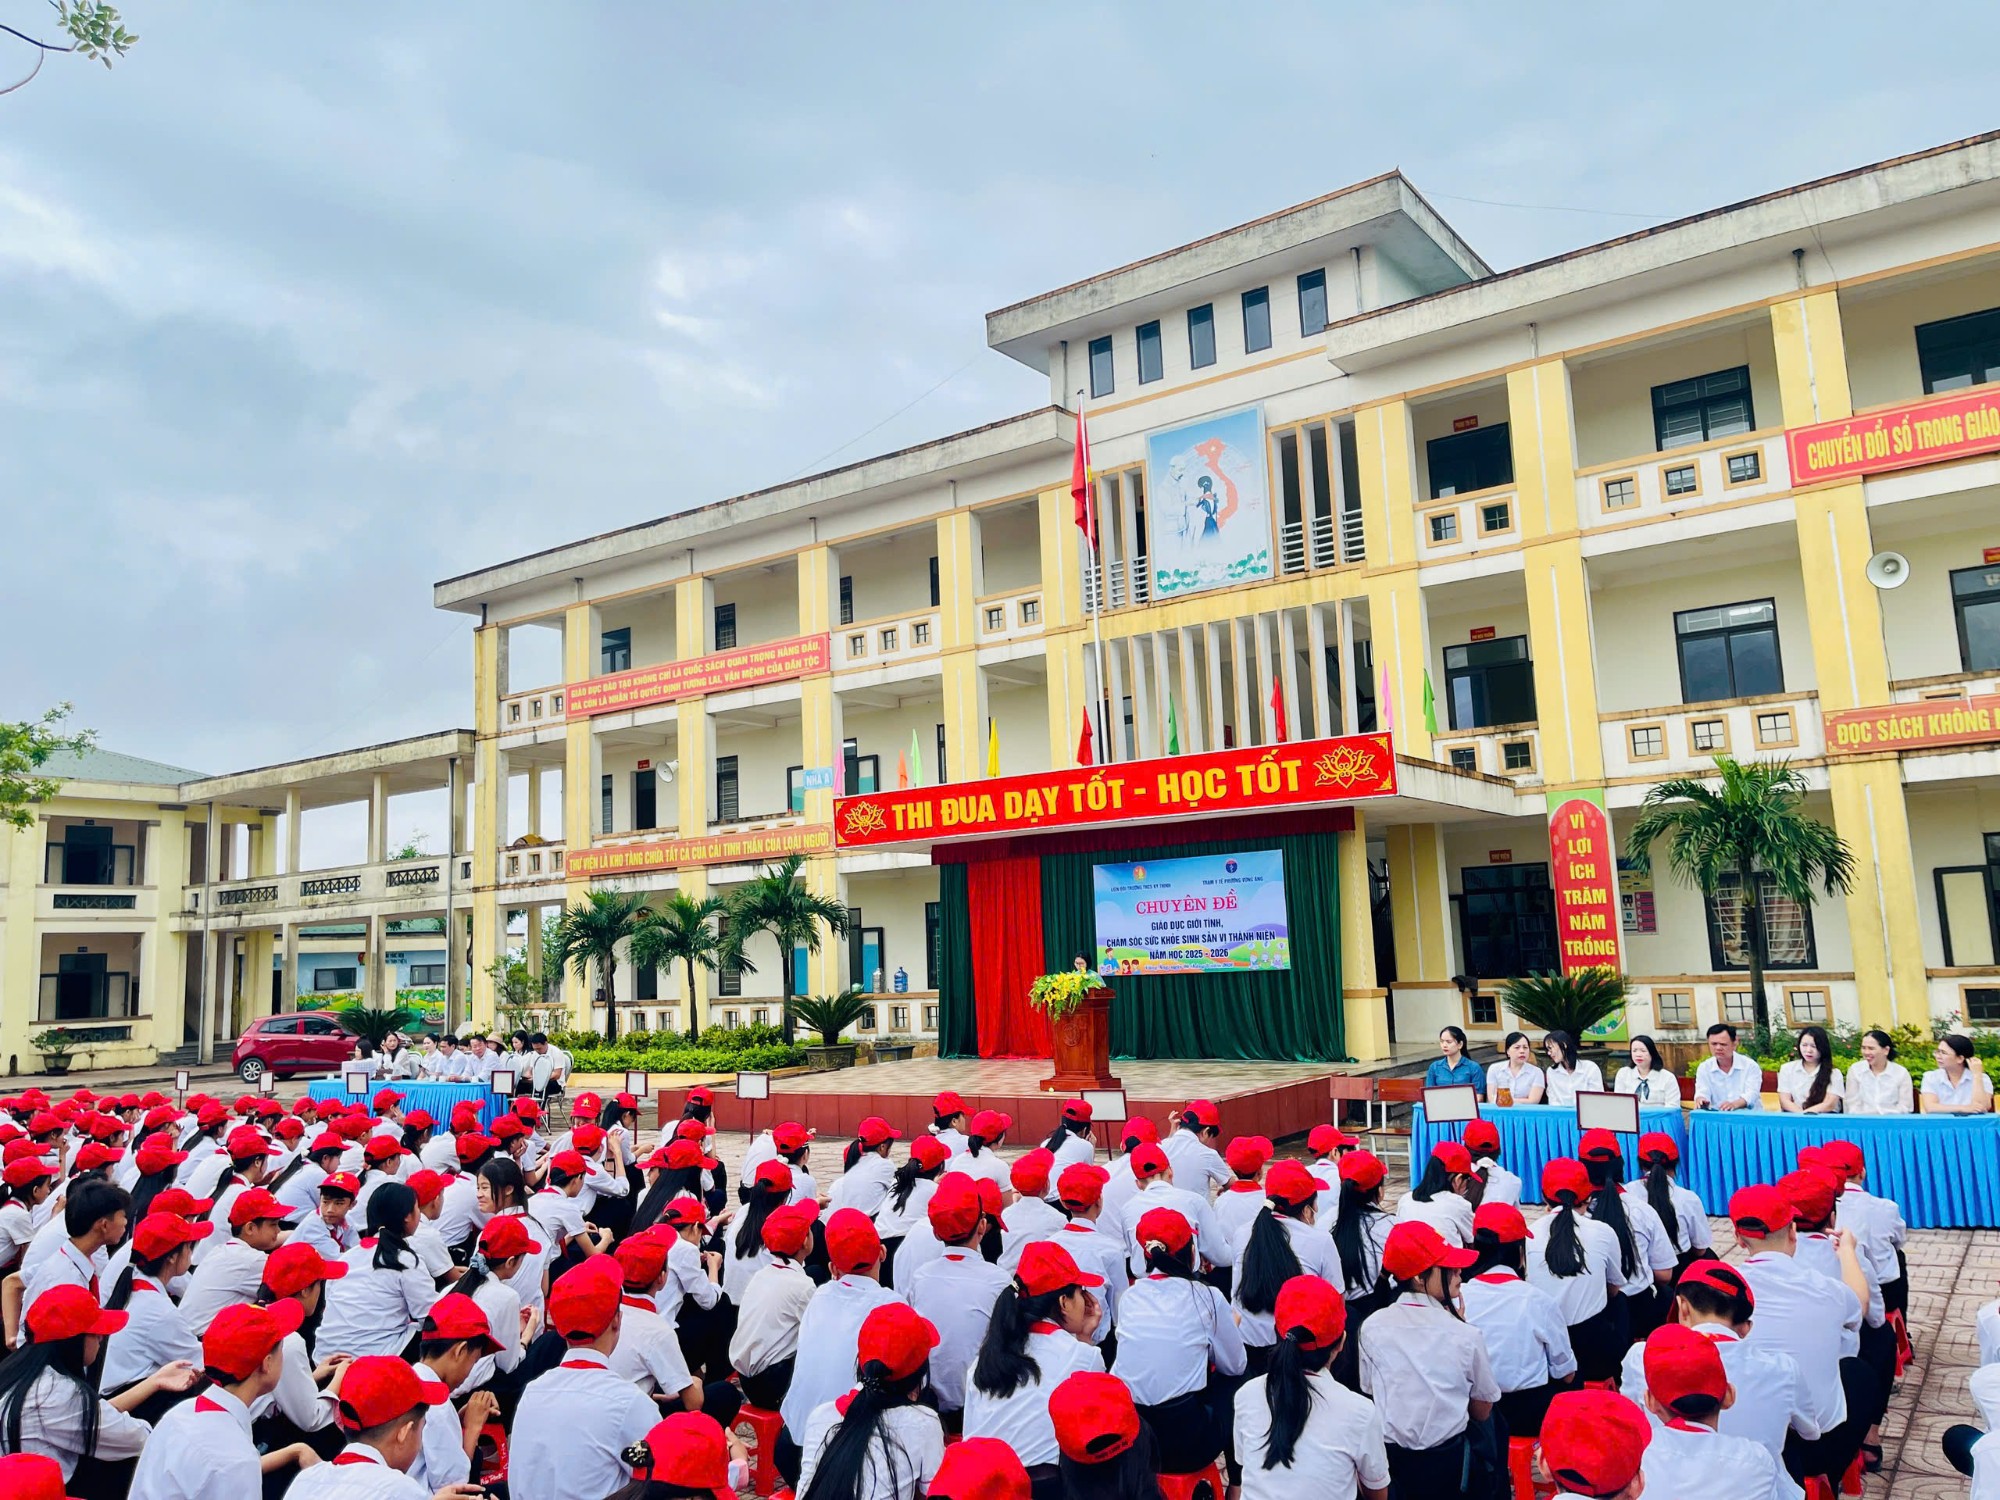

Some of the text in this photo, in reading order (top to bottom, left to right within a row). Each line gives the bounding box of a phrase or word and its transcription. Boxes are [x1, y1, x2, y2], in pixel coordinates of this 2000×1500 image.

[1807, 403, 2000, 471] CHUYỂN ĐỔI SỐ TRONG GIÁO
[571, 688, 586, 698] GIÁO
[588, 686, 601, 696] DỤC
[603, 681, 617, 692] ĐÀO
[619, 679, 632, 690] TẠO
[633, 674, 657, 687] KHÔNG
[659, 668, 671, 680] CHỈ
[673, 667, 682, 678] LÀ
[683, 662, 704, 675] QUỐC
[705, 660, 725, 672] SÁCH
[727, 655, 748, 668] QUAN
[750, 650, 776, 663] TRỌNG
[777, 645, 799, 657] HÀNG
[599, 696, 608, 706] LÀ
[609, 692, 628, 704] NHÂN
[629, 689, 638, 700] TỐ
[640, 686, 661, 699] QUYẾT
[663, 683, 681, 695] ĐỊNH
[682, 677, 706, 690] TƯƠNG
[724, 670, 740, 683] VẬN
[742, 666, 765, 680] MỆNH
[767, 662, 783, 674] CỦA
[785, 659, 802, 671] DÂN
[803, 656, 820, 669] TỘC
[1837, 721, 1872, 749] ĐỌC
[1876, 714, 1924, 742] SÁCH
[1928, 707, 1990, 736] KHÔNG
[824, 772, 830, 785] A
[891, 801, 933, 832] THI
[940, 796, 995, 827] ĐUA
[1003, 786, 1059, 823] DẠY
[1068, 769, 1125, 812] TỐT
[1158, 768, 1227, 809] HỌC
[1236, 749, 1303, 793] TỐT
[1570, 810, 1585, 830] VÌ
[569, 829, 829, 872] THƯ VIỆN LÀ KHO TÀNG CHỨA TẤT CẢ CỦA CẢI TINH THẦN CỦA LOÀI NGƯỜI
[1568, 838, 1592, 857] LỢI
[1570, 863, 1596, 880] ÍCH
[1136, 888, 1238, 915] CHUYÊN ĐỀ
[1563, 887, 1607, 905] TRĂM
[1151, 918, 1224, 932] GIÁO DỤC GIỚI TÍNH,
[1570, 912, 1606, 931] NĂM
[1106, 929, 1275, 948] CHĂM SÓC SỨC KHỎE SINH SẢN VỊ THÀNH NIÊN
[1564, 935, 1616, 956] TRỒNG
[1149, 948, 1166, 960] NĂM
[1168, 949, 1183, 961] HỌC
[1185, 949, 1203, 959] 2025
[1210, 948, 1229, 958] 2026
